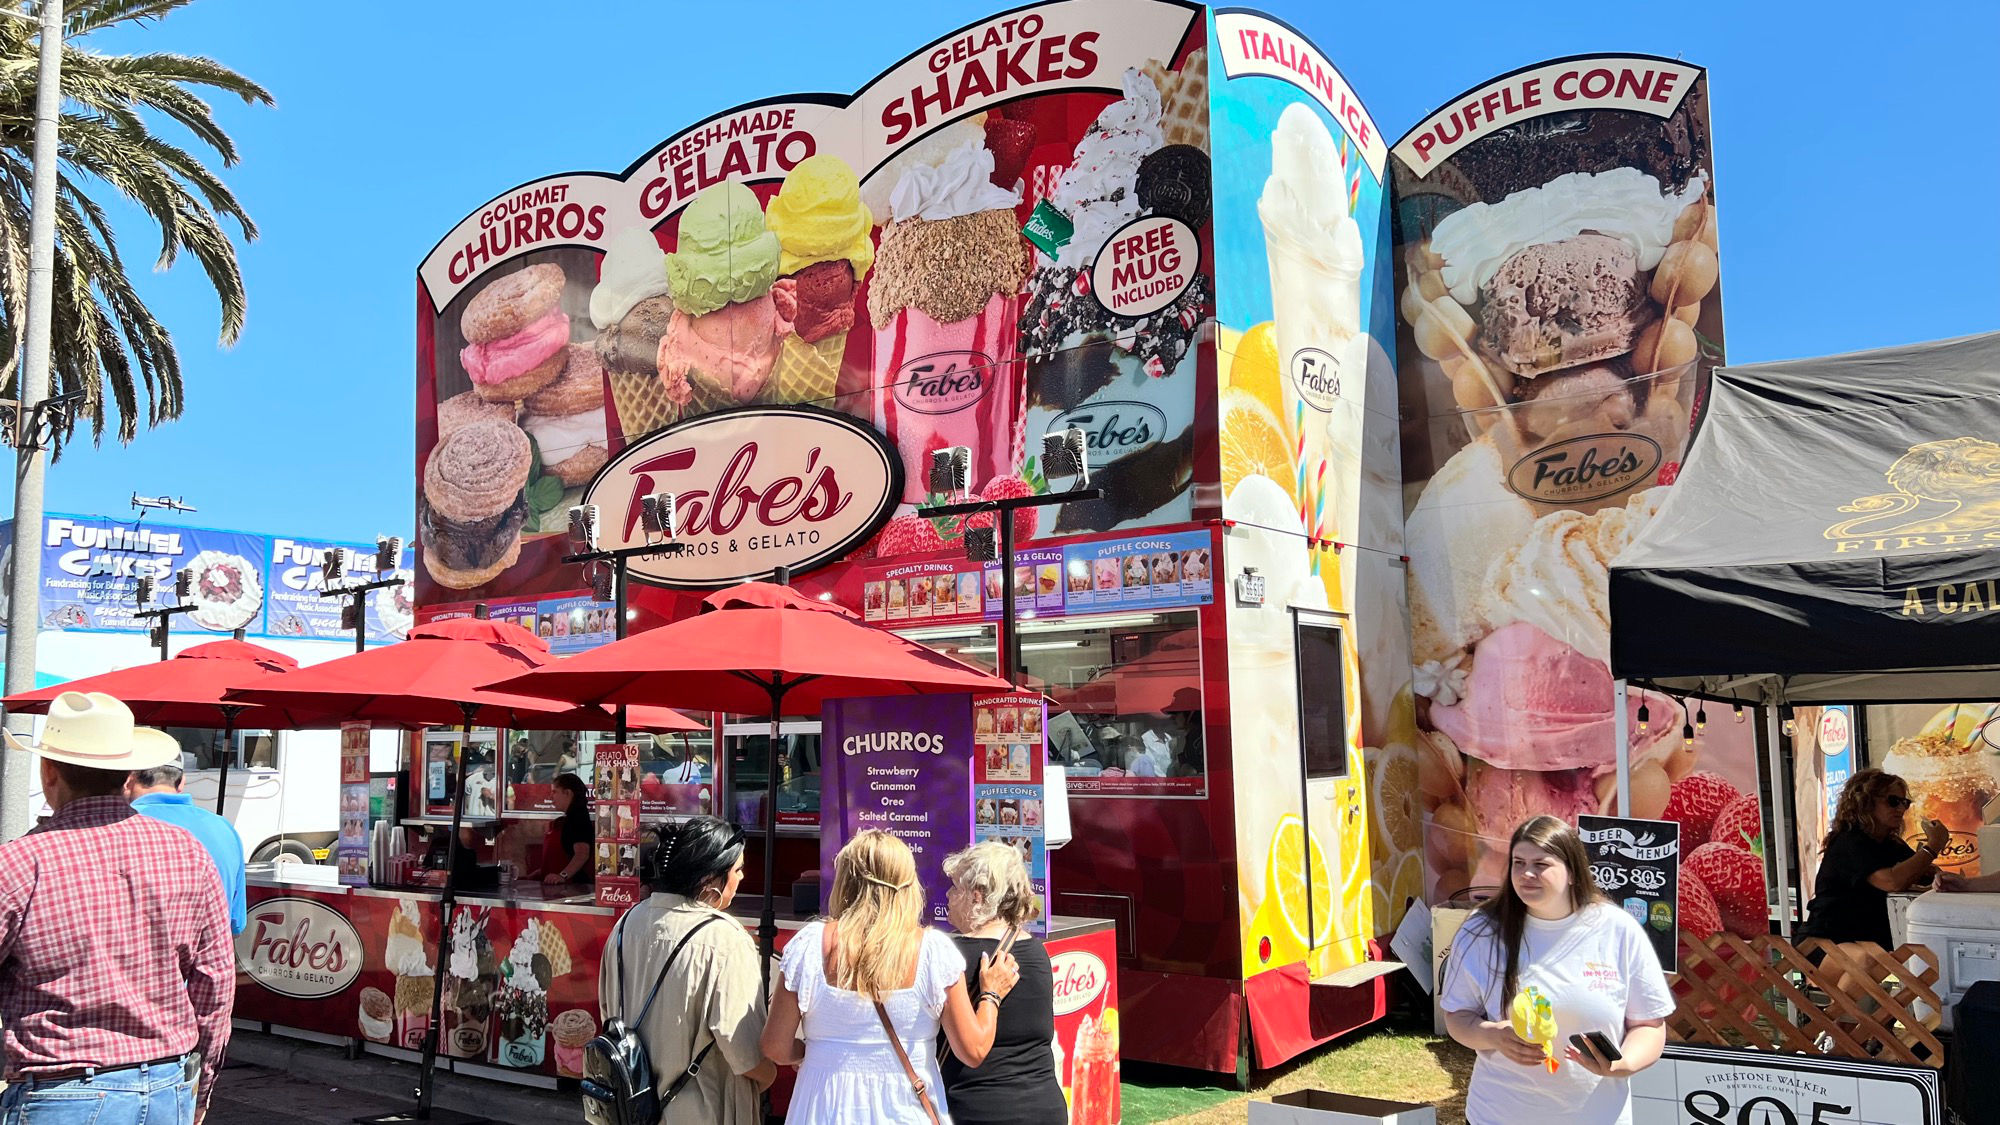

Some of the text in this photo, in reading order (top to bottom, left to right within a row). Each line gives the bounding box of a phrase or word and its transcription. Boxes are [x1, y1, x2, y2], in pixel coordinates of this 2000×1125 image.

[928, 14, 1044, 73] GELATO
[881, 31, 1100, 145] SHAKES
[1238, 29, 1370, 150] ITALIAN ICE
[1411, 68, 1679, 163] PUFFLE CONE
[657, 109, 796, 173] FRESH-MADE
[639, 131, 817, 219] GELATO
[480, 184, 569, 229] GOURMET
[1026, 219, 1054, 241] Andes
[448, 203, 606, 284] CHURROS
[1112, 223, 1175, 265] FREE
[1111, 247, 1181, 290] MUG
[1112, 273, 1184, 309] INCLUDED
[905, 363, 984, 397] Fabe's
[1301, 357, 1340, 395] Fabe's
[1532, 446, 1643, 490] Fabe's
[622, 441, 853, 543] Fabe's
[1543, 483, 1584, 496] CHURROS
[1596, 474, 1631, 487] GELATO
[47, 519, 184, 555] FUNNEL
[729, 539, 739, 552] &
[748, 530, 820, 550] GELATO
[1023, 553, 1030, 561] &
[1031, 552, 1062, 561] GELATO
[1097, 541, 1171, 557] PUFFLE CONES
[58, 550, 173, 580] CAKES
[886, 564, 954, 578] SPECIALTY DRINKS
[46, 578, 92, 590] Fundraising
[92, 580, 105, 590] for
[77, 591, 99, 599] Music
[489, 607, 512, 617] CHURROS
[517, 605, 537, 614] GELATO
[556, 600, 599, 611] PUFFLE CONES
[1901, 586, 1925, 616] A
[974, 697, 1043, 707] HANDCRAFTED DRINKS
[842, 731, 944, 756] CHURROS
[595, 751, 622, 760] GELATO
[595, 760, 612, 768] MILK
[867, 766, 919, 778] Strawberry
[870, 782, 916, 791] Cinnamon
[981, 787, 1038, 797] PUFFLE CONES
[881, 797, 905, 806] Oreo
[858, 812, 928, 822] Salted Caramel
[1589, 829, 1622, 842] BEER
[1636, 845, 1670, 859] MENU
[1629, 868, 1667, 887] 805
[600, 886, 632, 903] Fabe's
[251, 911, 348, 972] Fabe's
[258, 966, 293, 979] CHURROS
[304, 972, 335, 984] GELATO
[1053, 963, 1098, 997] abe's
[1705, 1072, 1828, 1096] FIRESTONE WALKER
[1767, 1085, 1806, 1097] COMPANY
